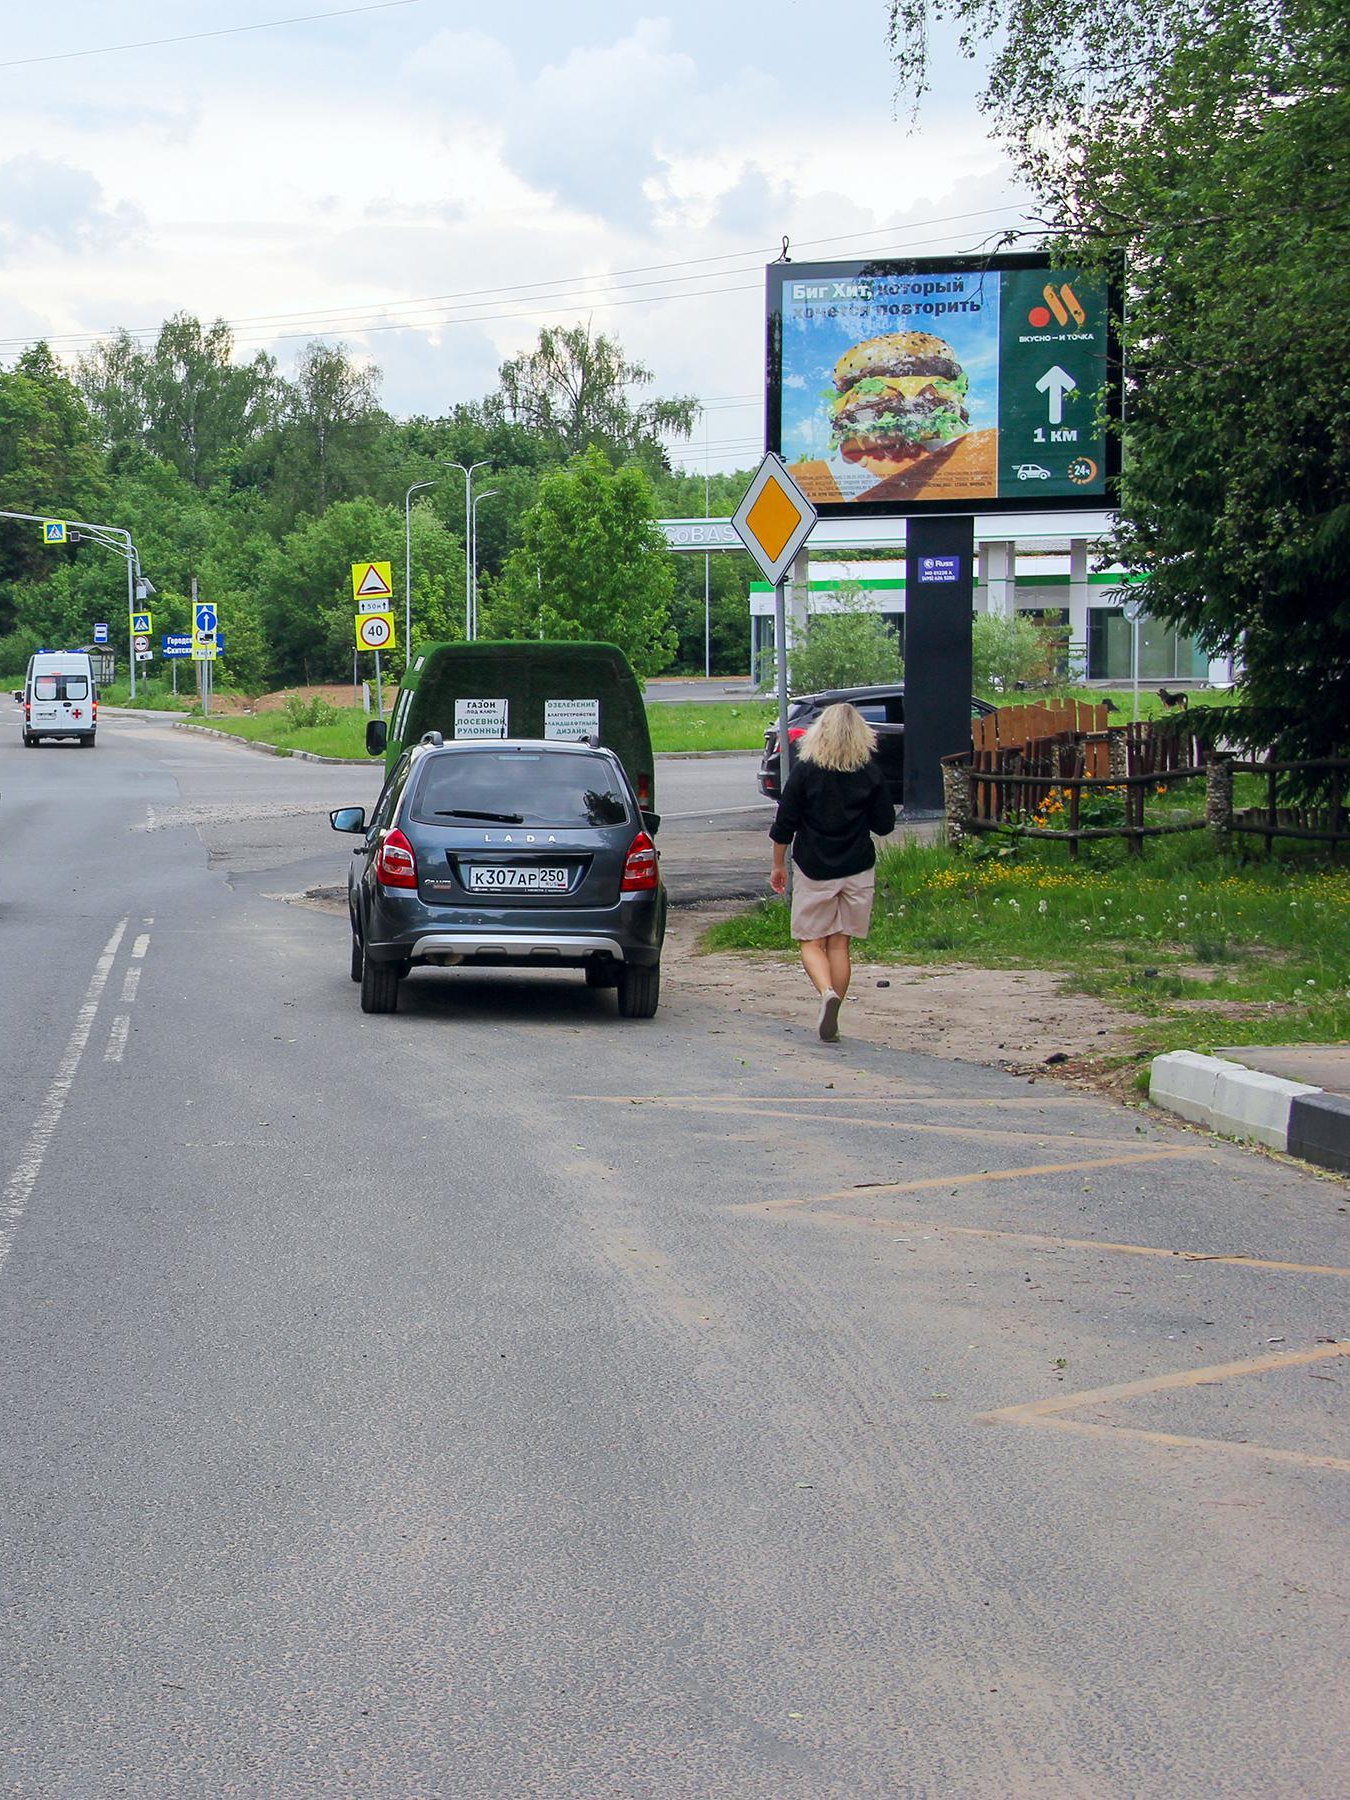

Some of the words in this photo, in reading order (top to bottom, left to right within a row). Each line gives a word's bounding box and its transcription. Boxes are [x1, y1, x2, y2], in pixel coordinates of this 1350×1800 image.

[793, 284, 828, 300] Биг
[832, 283, 872, 301] Хит,
[877, 277, 964, 297] который
[876, 300, 981, 317] повторить
[1019, 334, 1051, 343] ВКУСНО
[1066, 333, 1095, 341] ТОЧКА
[1033, 427, 1046, 443] 1
[367, 625, 383, 637] 40
[467, 701, 496, 709] ГАЗОН
[556, 727, 587, 735] ДИЗАЙН
[484, 834, 557, 843] LADA
